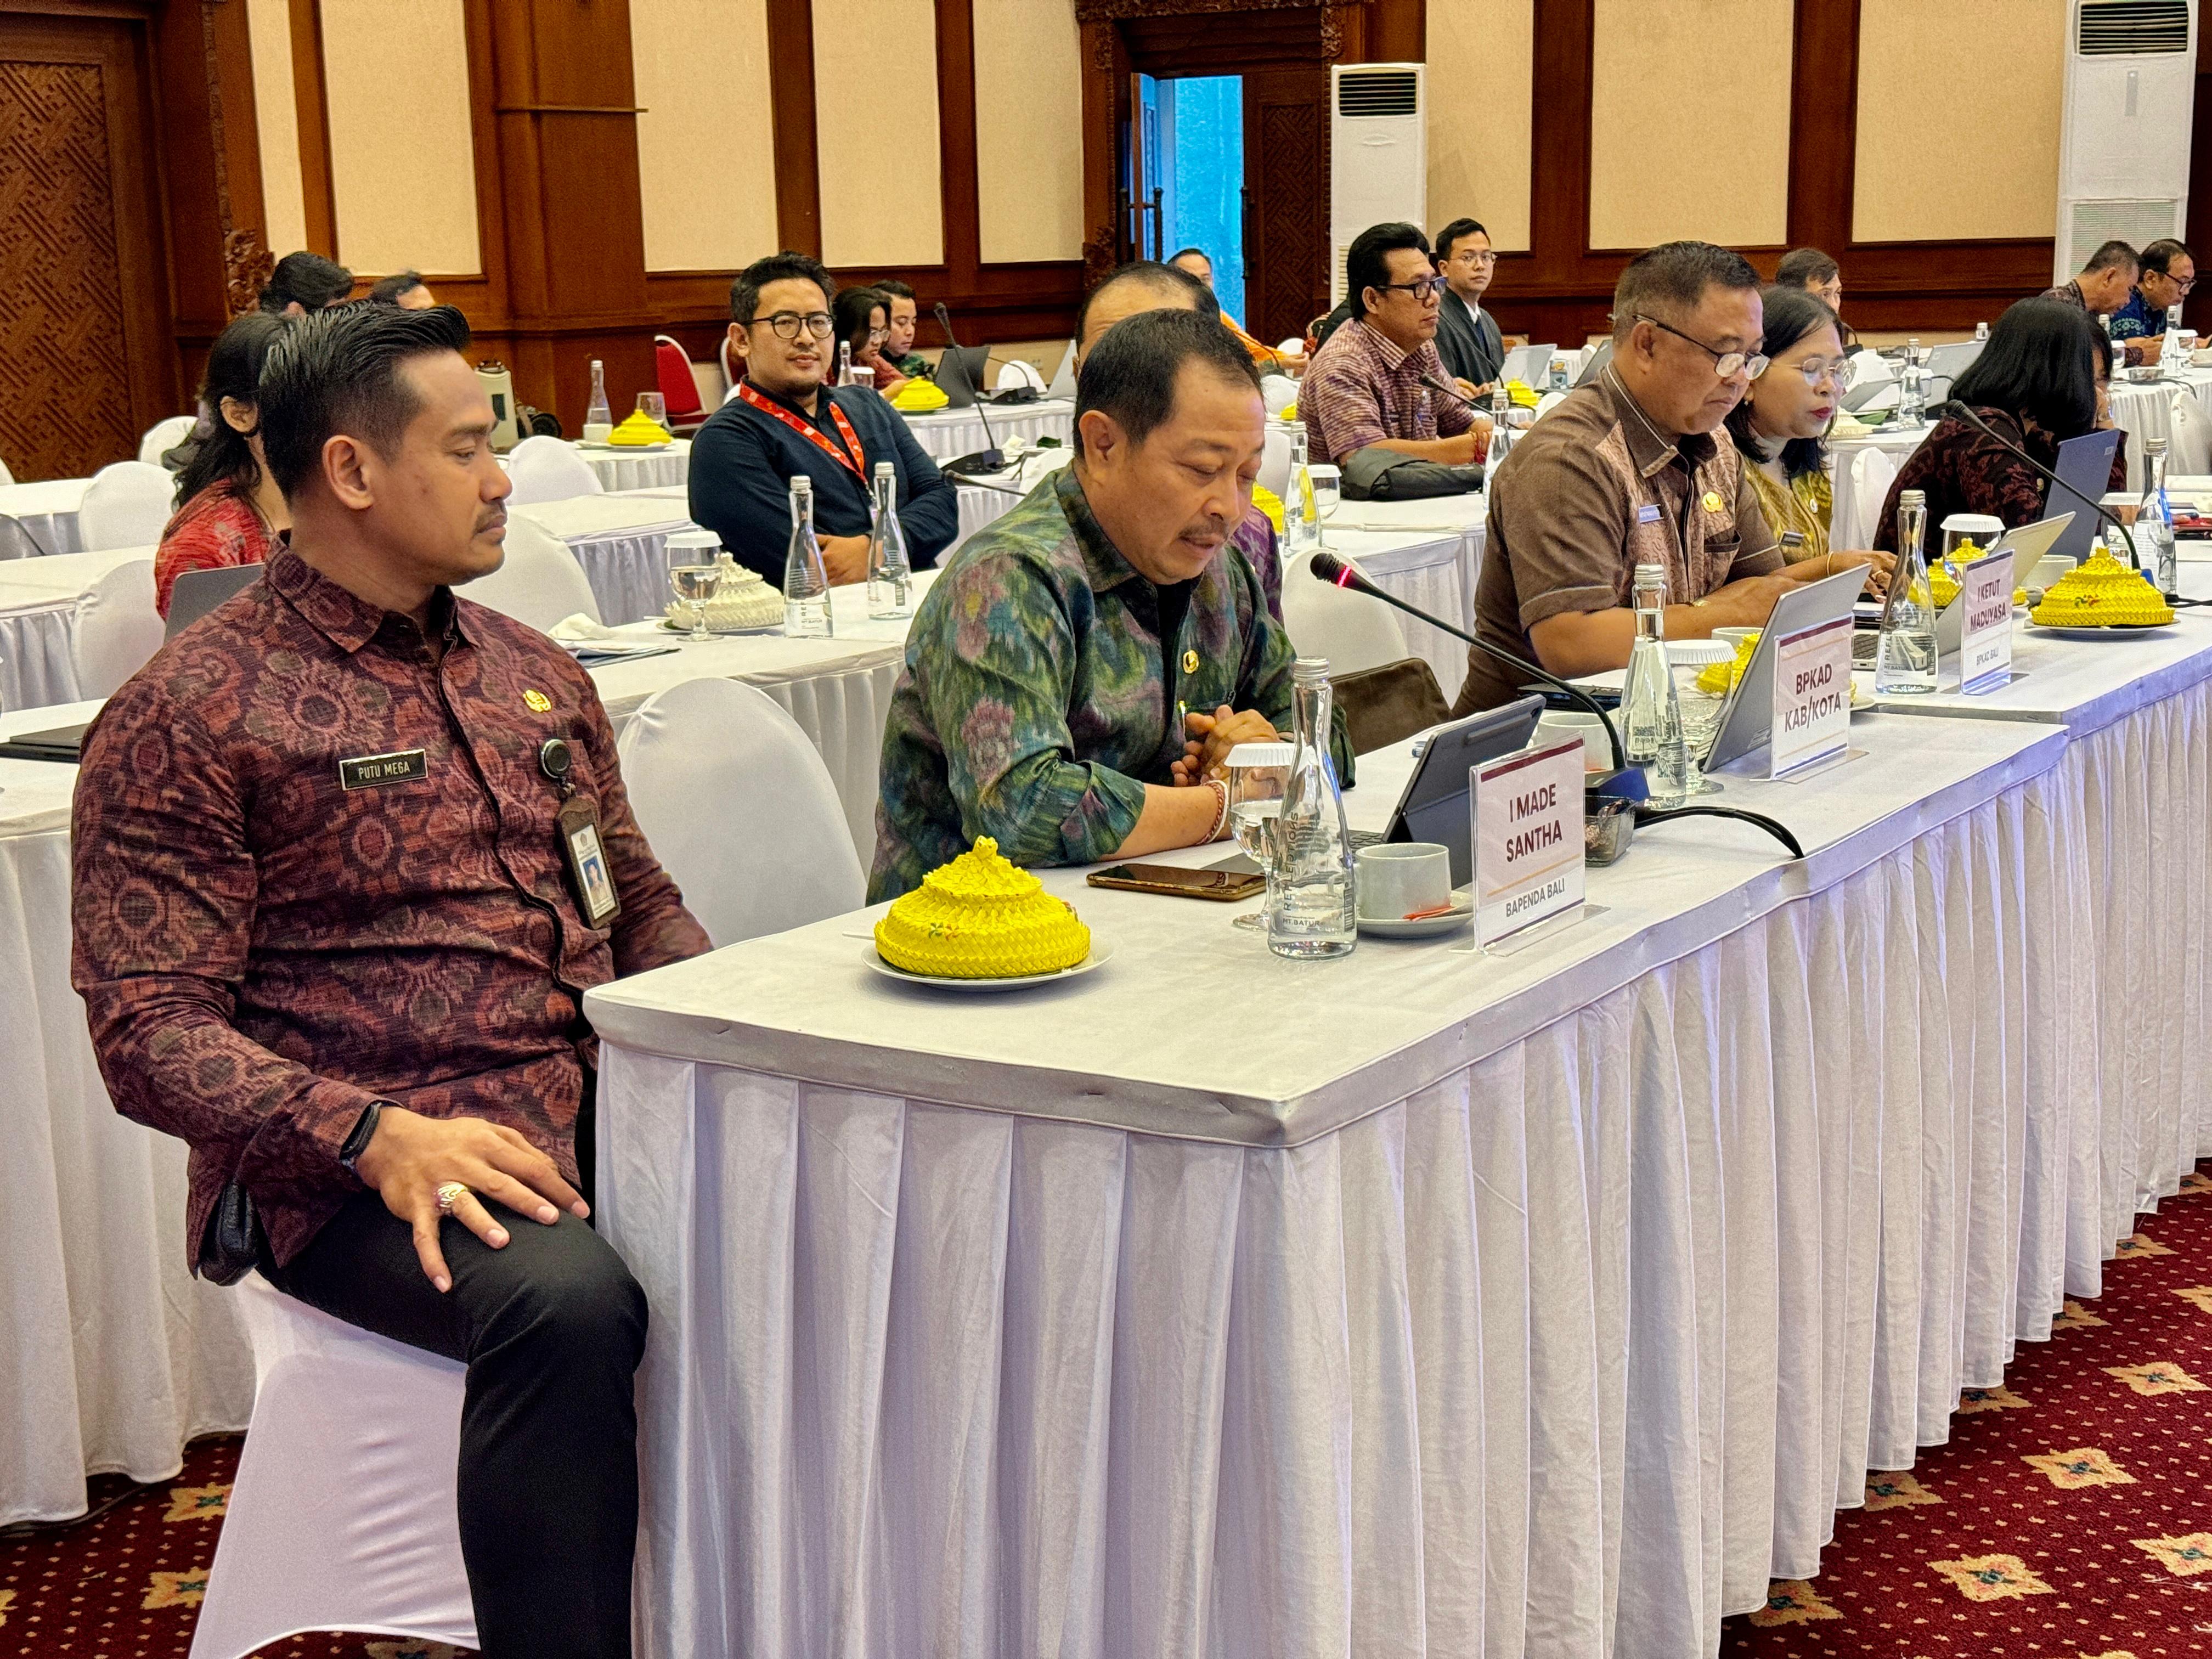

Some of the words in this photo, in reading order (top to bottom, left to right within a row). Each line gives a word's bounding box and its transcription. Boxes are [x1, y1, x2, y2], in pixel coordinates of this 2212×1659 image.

[1981, 579, 2000, 601] KETUT
[1970, 602, 2006, 632] MADUYASA
[1796, 663, 1832, 695] BPKAD
[1785, 691, 1841, 733] KAB/KOTA
[359, 765, 381, 780] PUTU
[385, 761, 410, 776] MEGA
[1509, 799, 1513, 823] I
[1517, 783, 1556, 820] MADE
[1506, 820, 1562, 862] SANTHA
[1506, 887, 1545, 918] BAPENDA
[1547, 878, 1565, 899] BALI
